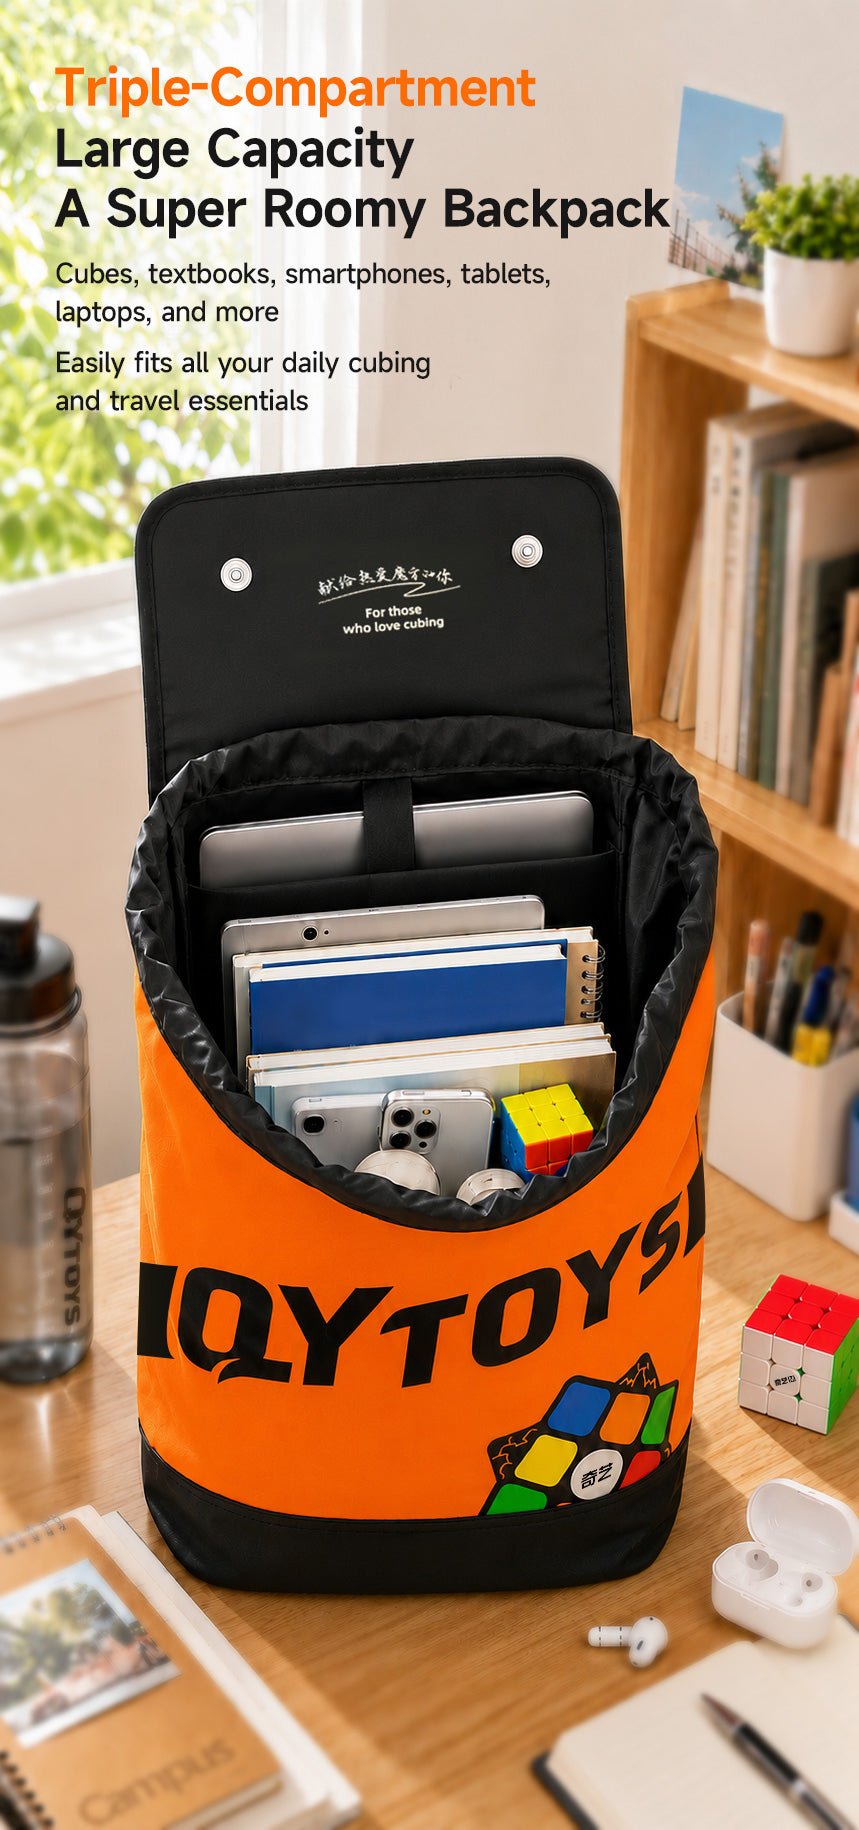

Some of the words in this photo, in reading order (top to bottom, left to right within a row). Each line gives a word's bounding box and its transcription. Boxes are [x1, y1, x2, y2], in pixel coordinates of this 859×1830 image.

[343, 623, 372, 635] who
[375, 621, 401, 632] love
[403, 617, 444, 629] cubing
[365, 607, 386, 619] For
[388, 605, 422, 617] those
[63, 1186, 87, 1326] QYTOYS
[178, 1192, 682, 1387] QYTOYS
[581, 1462, 614, 1489] 奇艺
[77, 1738, 236, 1825] Campus
